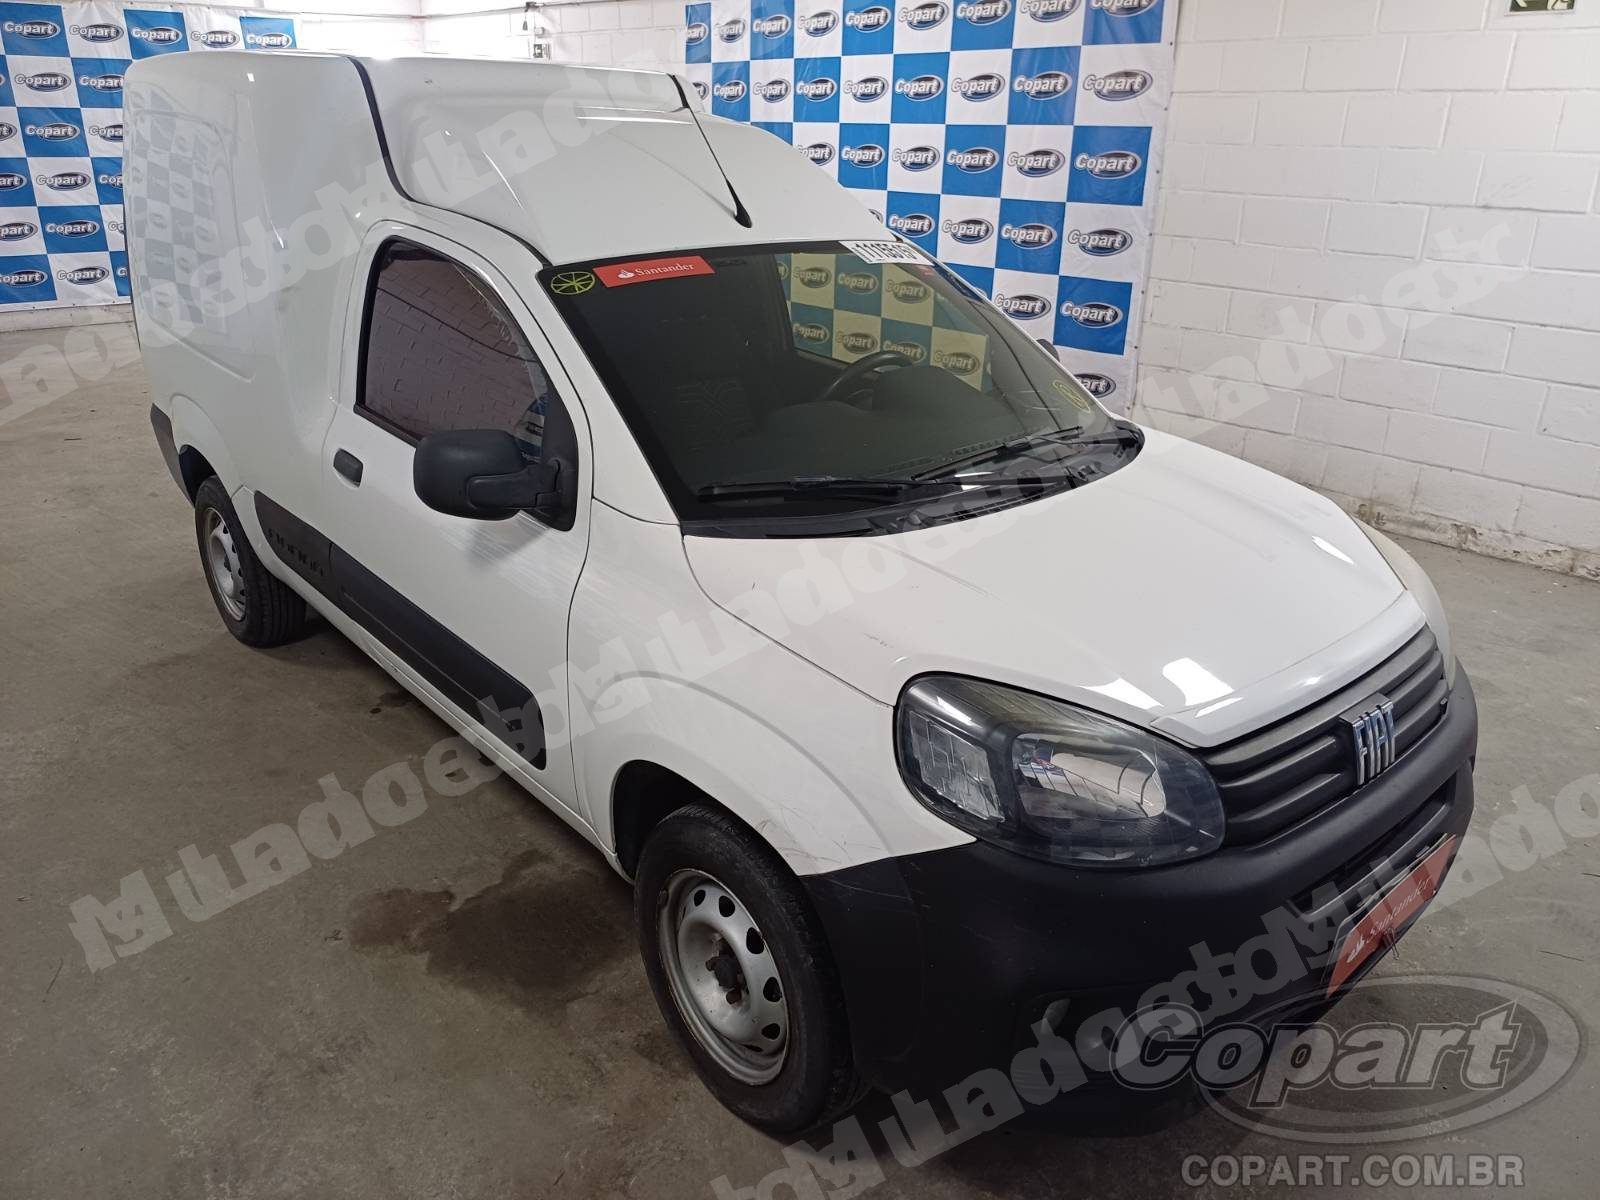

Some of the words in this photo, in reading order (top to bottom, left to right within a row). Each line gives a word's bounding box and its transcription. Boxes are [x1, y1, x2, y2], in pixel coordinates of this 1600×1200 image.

[900, 4, 942, 23] Copart
[956, 0, 1007, 19] Copart
[753, 15, 787, 35] Copart
[799, 14, 834, 32] Copart
[845, 10, 886, 28] Copart
[4, 21, 54, 35] Copart
[69, 24, 117, 38] Copart
[131, 27, 177, 42] Copart
[687, 26, 704, 39] part
[191, 30, 234, 45] Copart
[246, 33, 288, 47] Copart
[15, 73, 65, 88] Copart
[753, 80, 787, 97] Copart
[796, 79, 833, 97] Copart
[844, 78, 883, 97] Copart
[895, 76, 938, 95] Copart
[951, 75, 1001, 95] Copart
[1014, 74, 1065, 94] Copart
[1083, 73, 1143, 92] Copart
[714, 82, 743, 99] Copart
[26, 125, 74, 137] Copart
[89, 125, 123, 138] Copa
[841, 148, 881, 165] Copart
[892, 149, 934, 167] Copart
[946, 150, 994, 167] Copart
[1007, 151, 1055, 169] Copart
[1075, 154, 1134, 172] Copart
[0, 176, 20, 186] art
[36, 174, 84, 188] Copart
[99, 175, 123, 187] Cop
[0, 225, 29, 238] part
[45, 223, 93, 236] Copart
[889, 215, 931, 232] Copart
[943, 219, 986, 239] Copart
[1002, 223, 1050, 243] Copart
[1069, 230, 1125, 250] Copart
[57, 267, 102, 281] Copart
[635, 263, 695, 277] Santander
[838, 273, 875, 290] Copart
[886, 280, 925, 299] Copart
[995, 294, 1043, 314] Copart
[1062, 303, 1116, 322] Copart
[934, 352, 973, 371] Copart
[1083, 379, 1106, 394] art
[1352, 701, 1396, 786] FIAT
